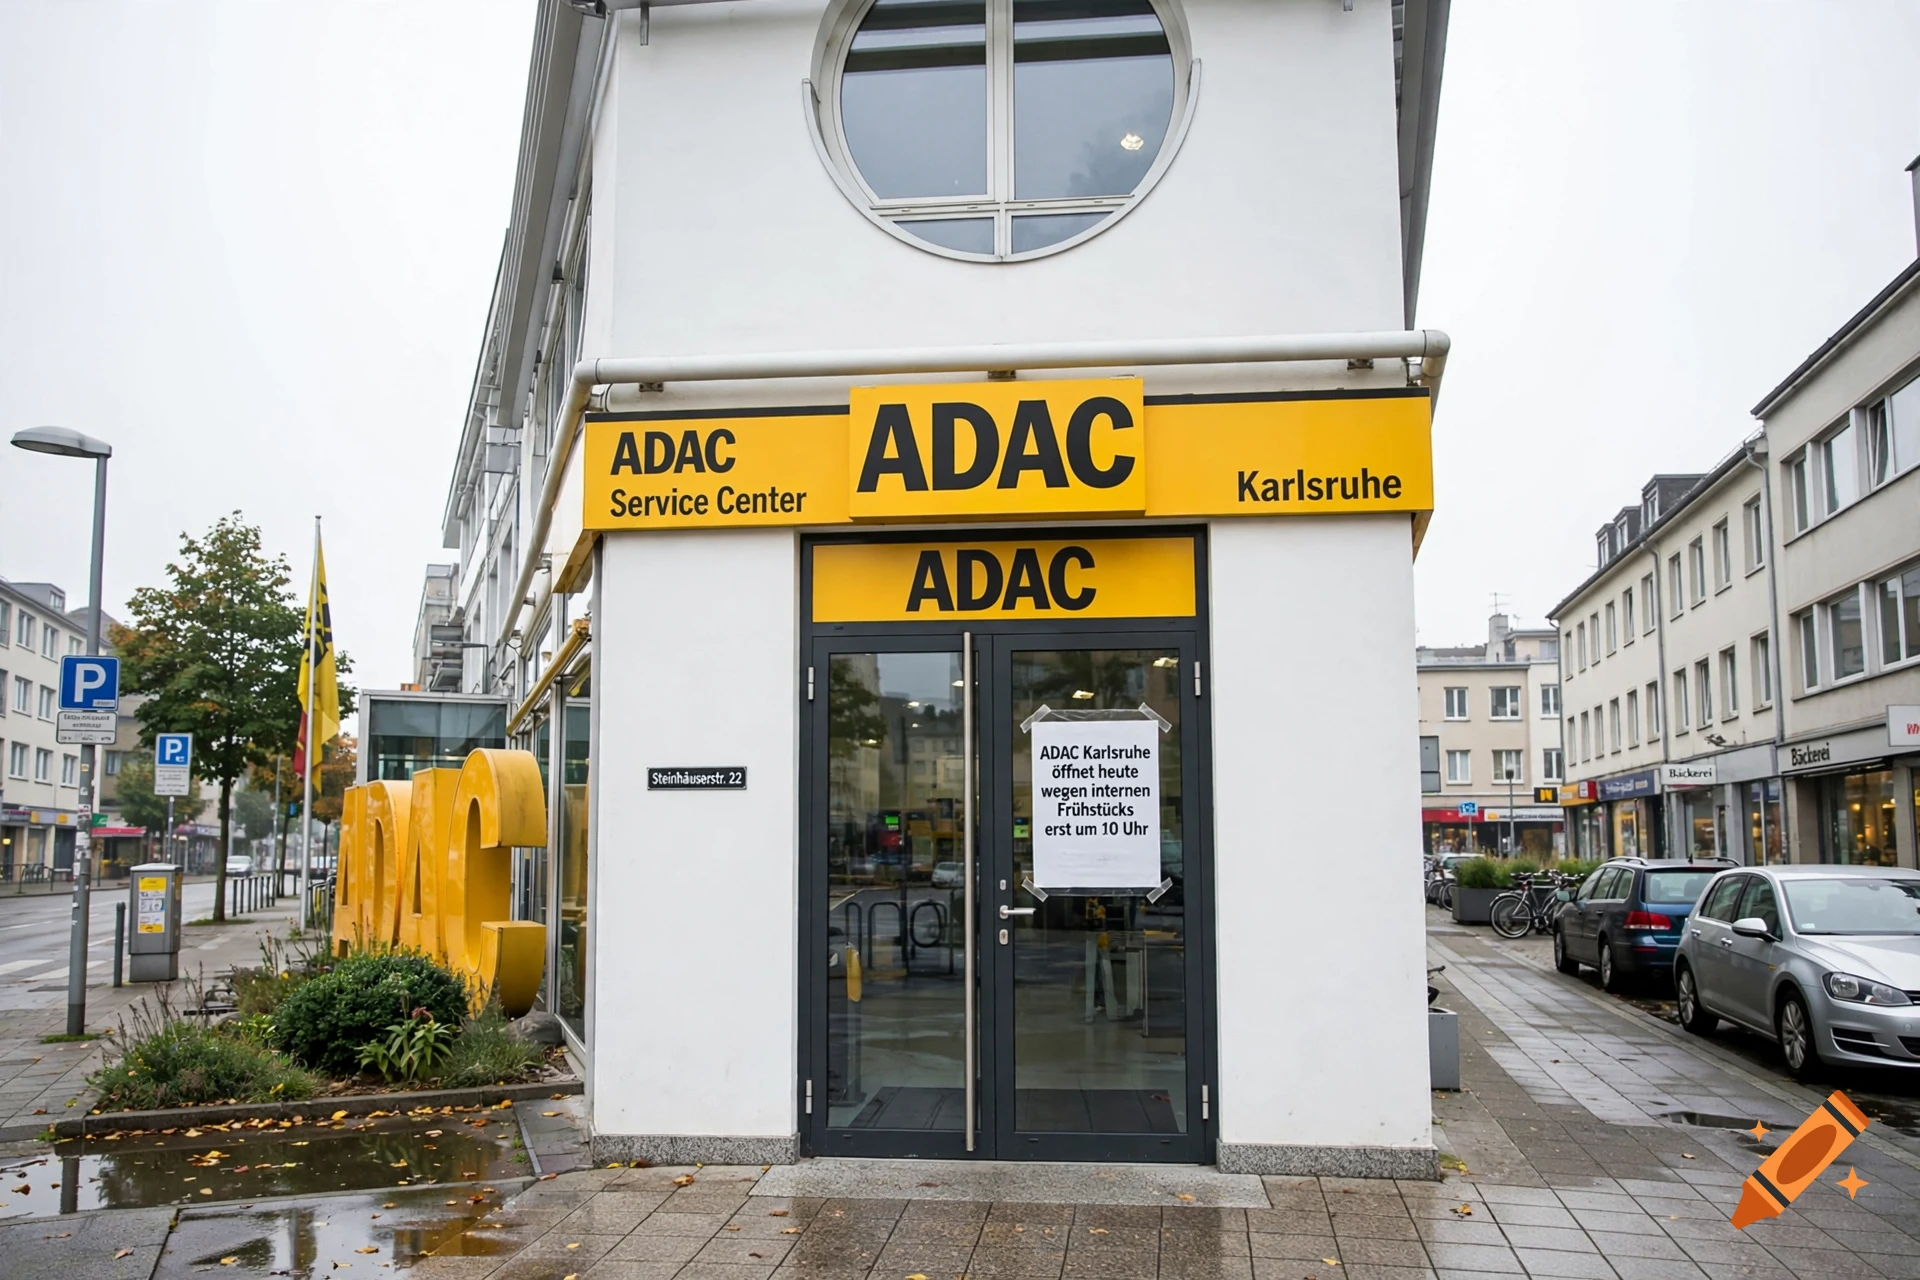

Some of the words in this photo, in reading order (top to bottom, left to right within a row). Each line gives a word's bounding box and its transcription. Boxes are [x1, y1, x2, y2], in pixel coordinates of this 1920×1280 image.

[611, 428, 735, 475] ADAC
[857, 396, 1135, 492] ADAC
[1238, 467, 1401, 502] Karlsruhe
[611, 488, 709, 518] Service
[716, 485, 807, 515] Center
[906, 546, 1097, 612] ADAC
[74, 664, 107, 703] P
[165, 739, 183, 761] P
[1040, 745, 1079, 760] ADAC
[1083, 744, 1151, 760] Karlsruhe
[652, 772, 726, 785] Steinhäuserstr.
[729, 772, 742, 784] 22
[1052, 764, 1095, 779] öffnet
[1098, 764, 1139, 779] heute
[1041, 786, 1088, 801] wegen
[1091, 783, 1151, 798] internen
[1057, 802, 1135, 817] Frühstücks
[1044, 823, 1072, 836] erst
[1075, 825, 1097, 836] um
[1102, 822, 1118, 836] 10
[1123, 821, 1149, 836] Uhr
[333, 748, 547, 1018] ADAC
